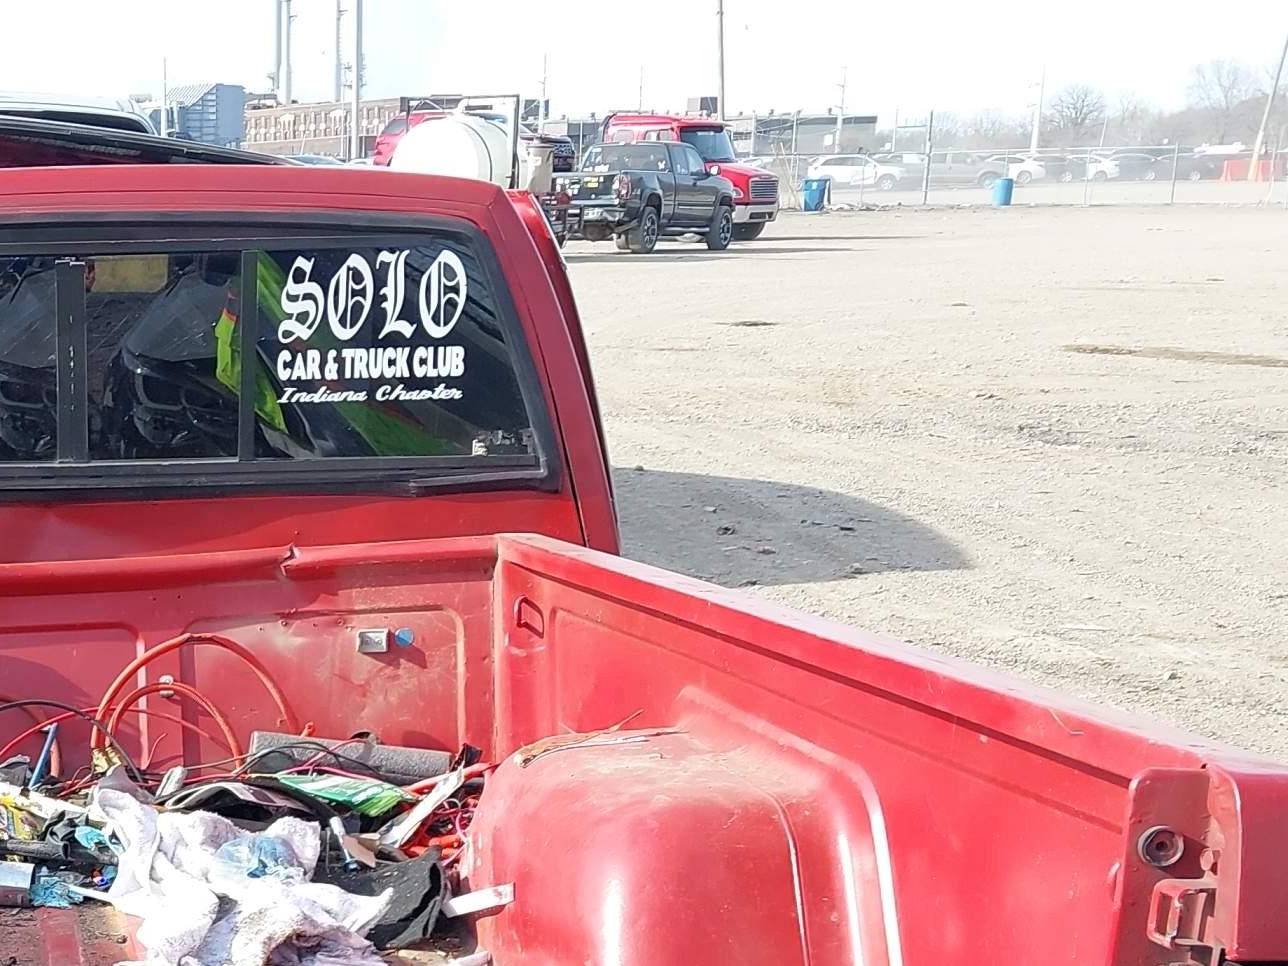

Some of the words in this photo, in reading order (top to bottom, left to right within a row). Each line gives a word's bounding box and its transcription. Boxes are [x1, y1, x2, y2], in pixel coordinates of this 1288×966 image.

[277, 249, 468, 344] SOLO
[277, 348, 322, 381] CAR
[324, 348, 339, 381] &
[341, 346, 411, 380] TRUCK
[412, 345, 465, 378] CLUB
[276, 386, 368, 404] Indiana
